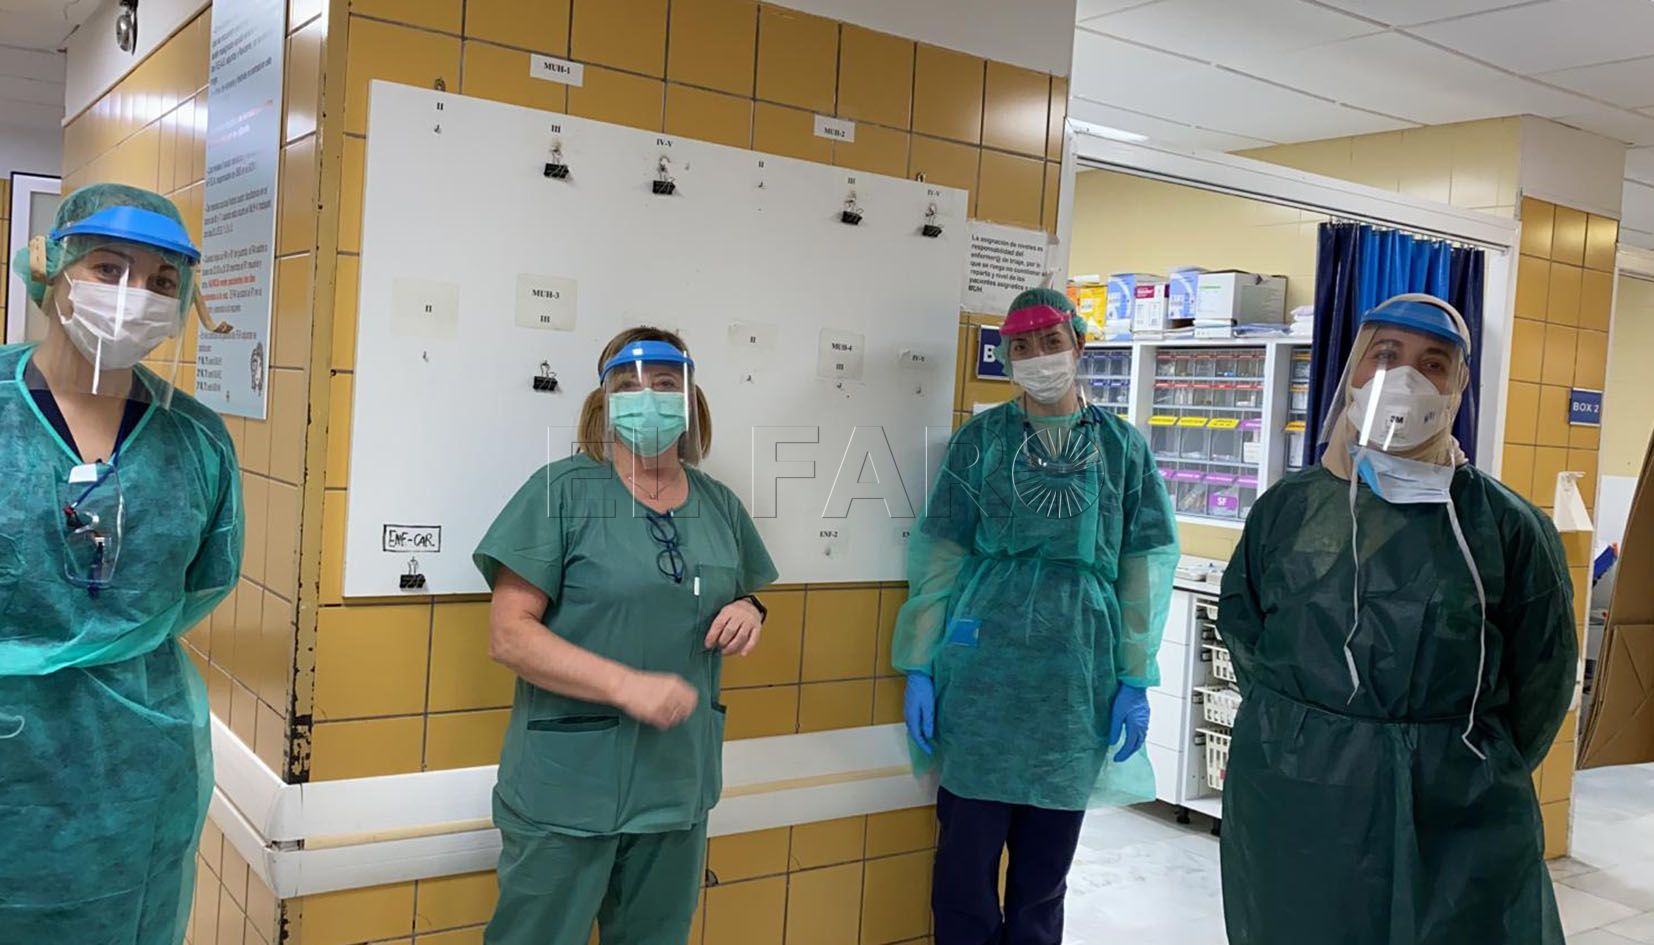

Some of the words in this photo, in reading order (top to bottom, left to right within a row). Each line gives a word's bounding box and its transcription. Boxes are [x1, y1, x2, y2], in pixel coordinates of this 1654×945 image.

[543, 61, 571, 75] MUH-1
[436, 102, 444, 111] II
[551, 124, 561, 133] III
[824, 126, 846, 138] MUH-2
[656, 138, 673, 148] IV-V
[971, 243, 1014, 256] responsabilidad
[1017, 243, 1036, 251] niveles
[990, 263, 1005, 271] ruega
[1026, 261, 1035, 269] por
[970, 269, 991, 277] reparto
[996, 272, 1008, 280] nivel
[969, 277, 996, 287] pacientes
[997, 281, 1024, 290] asignados
[532, 288, 560, 300] MUH-3
[425, 304, 433, 313] II
[539, 314, 550, 324] III
[1572, 401, 1592, 413] BOX
[1593, 404, 1600, 414] 2
[387, 529, 435, 548] ENF-CAR
